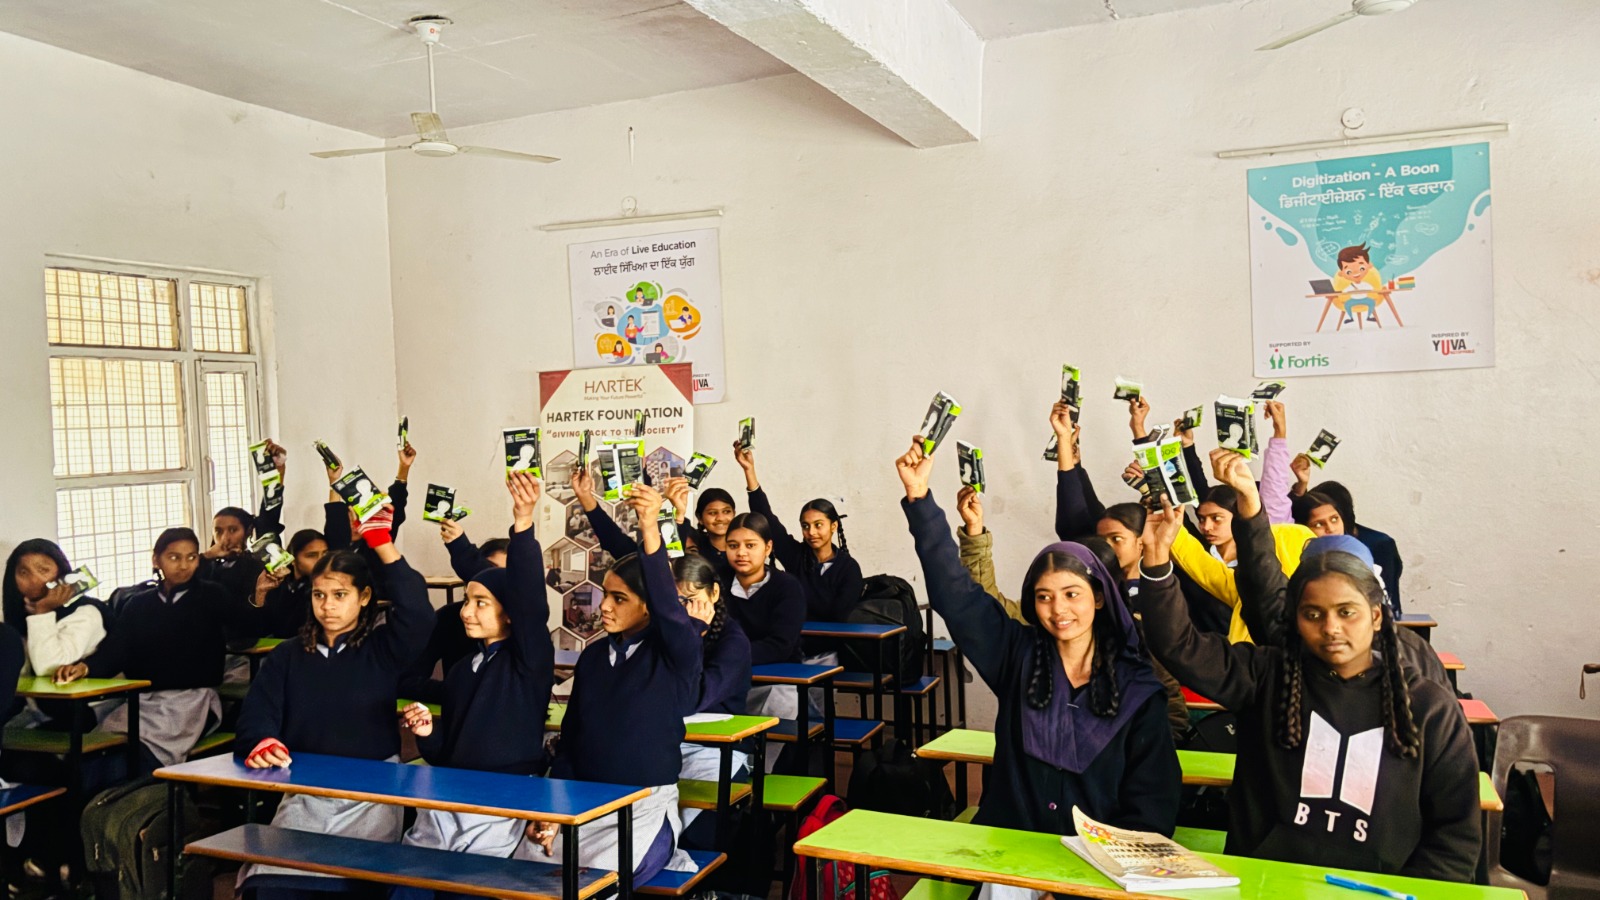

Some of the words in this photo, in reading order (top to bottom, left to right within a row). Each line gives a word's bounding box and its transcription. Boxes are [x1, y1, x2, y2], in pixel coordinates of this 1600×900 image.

[1292, 171, 1371, 188] Digitization
[1384, 166, 1397, 178] A
[1400, 163, 1439, 176] Boon
[1407, 180, 1455, 195] ਵਰਦਾਨ
[590, 250, 602, 259] An
[604, 248, 618, 258] Era
[620, 246, 629, 256] of
[631, 245, 649, 255] Live
[652, 240, 696, 253] Education
[593, 263, 618, 276] ਲਾਈਵ
[649, 261, 659, 270] ਦਾ
[1432, 339, 1467, 356] YUVA
[1288, 354, 1330, 368] Fortis
[584, 378, 643, 394] HARTEK
[693, 379, 709, 392] UVA
[546, 410, 594, 423] HARTEK
[585, 429, 607, 437] ACK
[624, 428, 636, 436] TH
[1293, 801, 1369, 842] BTS
